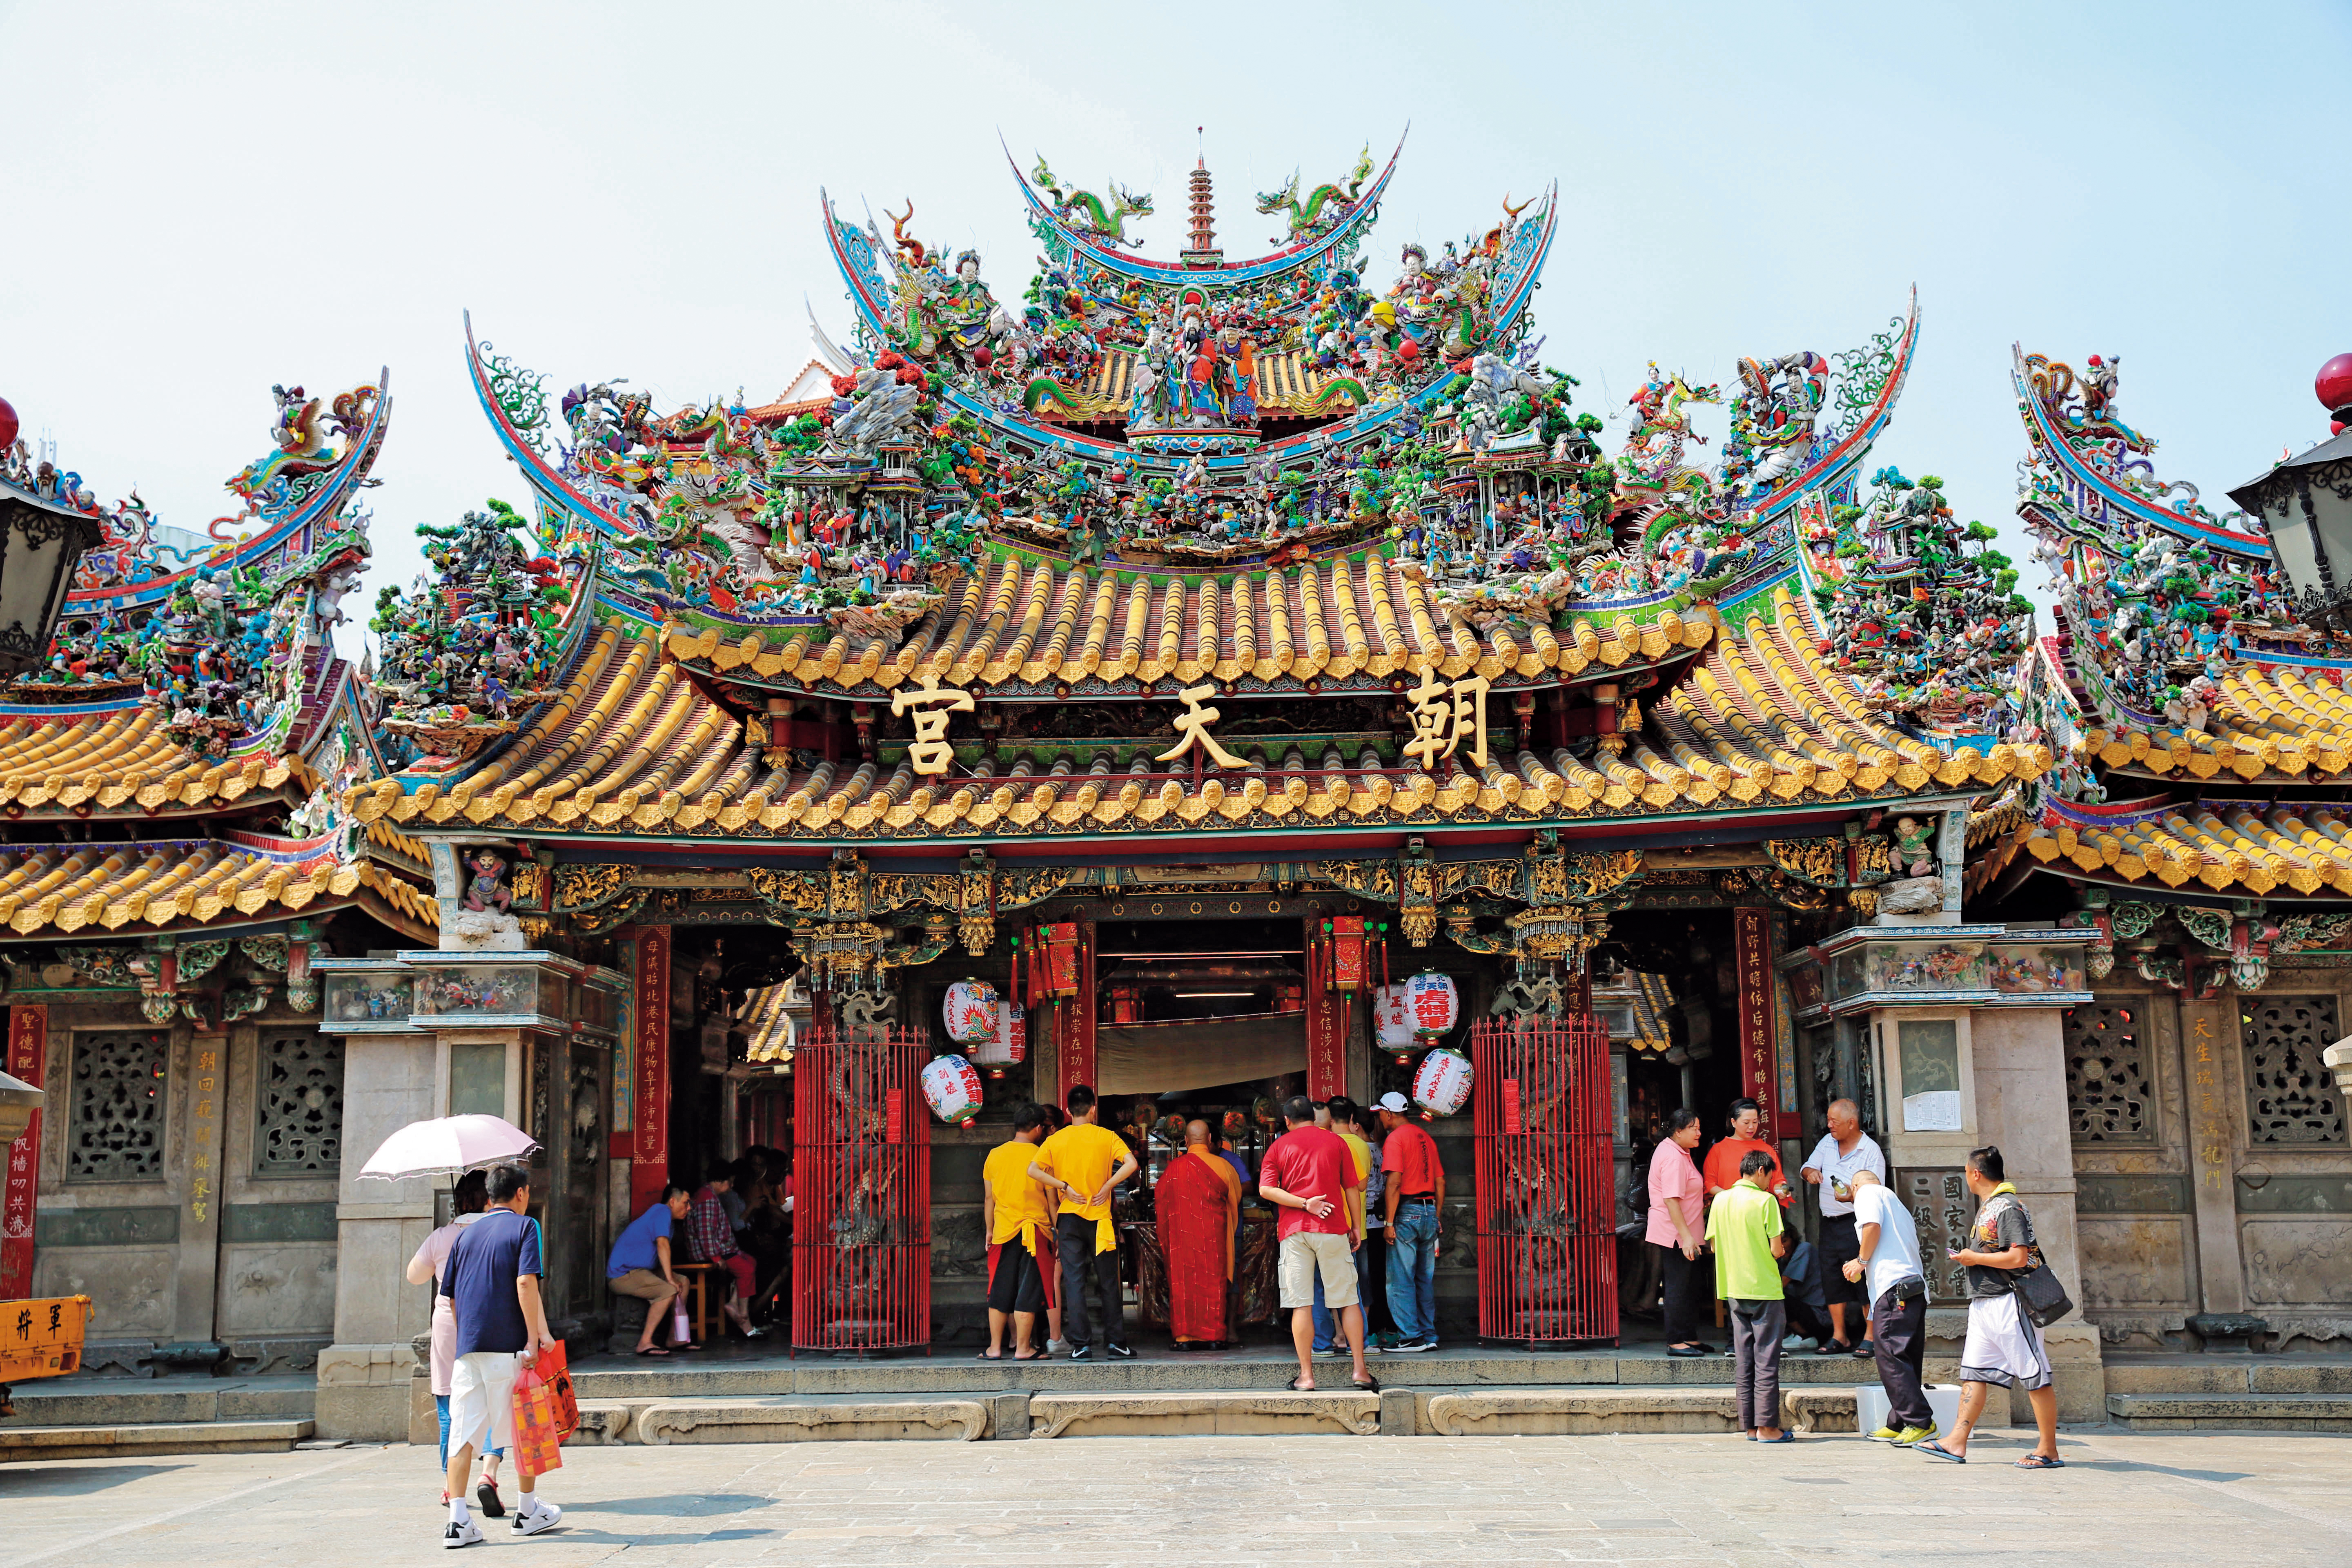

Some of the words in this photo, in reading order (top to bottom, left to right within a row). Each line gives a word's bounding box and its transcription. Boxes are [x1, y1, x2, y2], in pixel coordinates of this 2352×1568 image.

[1069, 993, 1083, 1085] 報崇在功德
[1414, 990, 1450, 1029] 虎將軍
